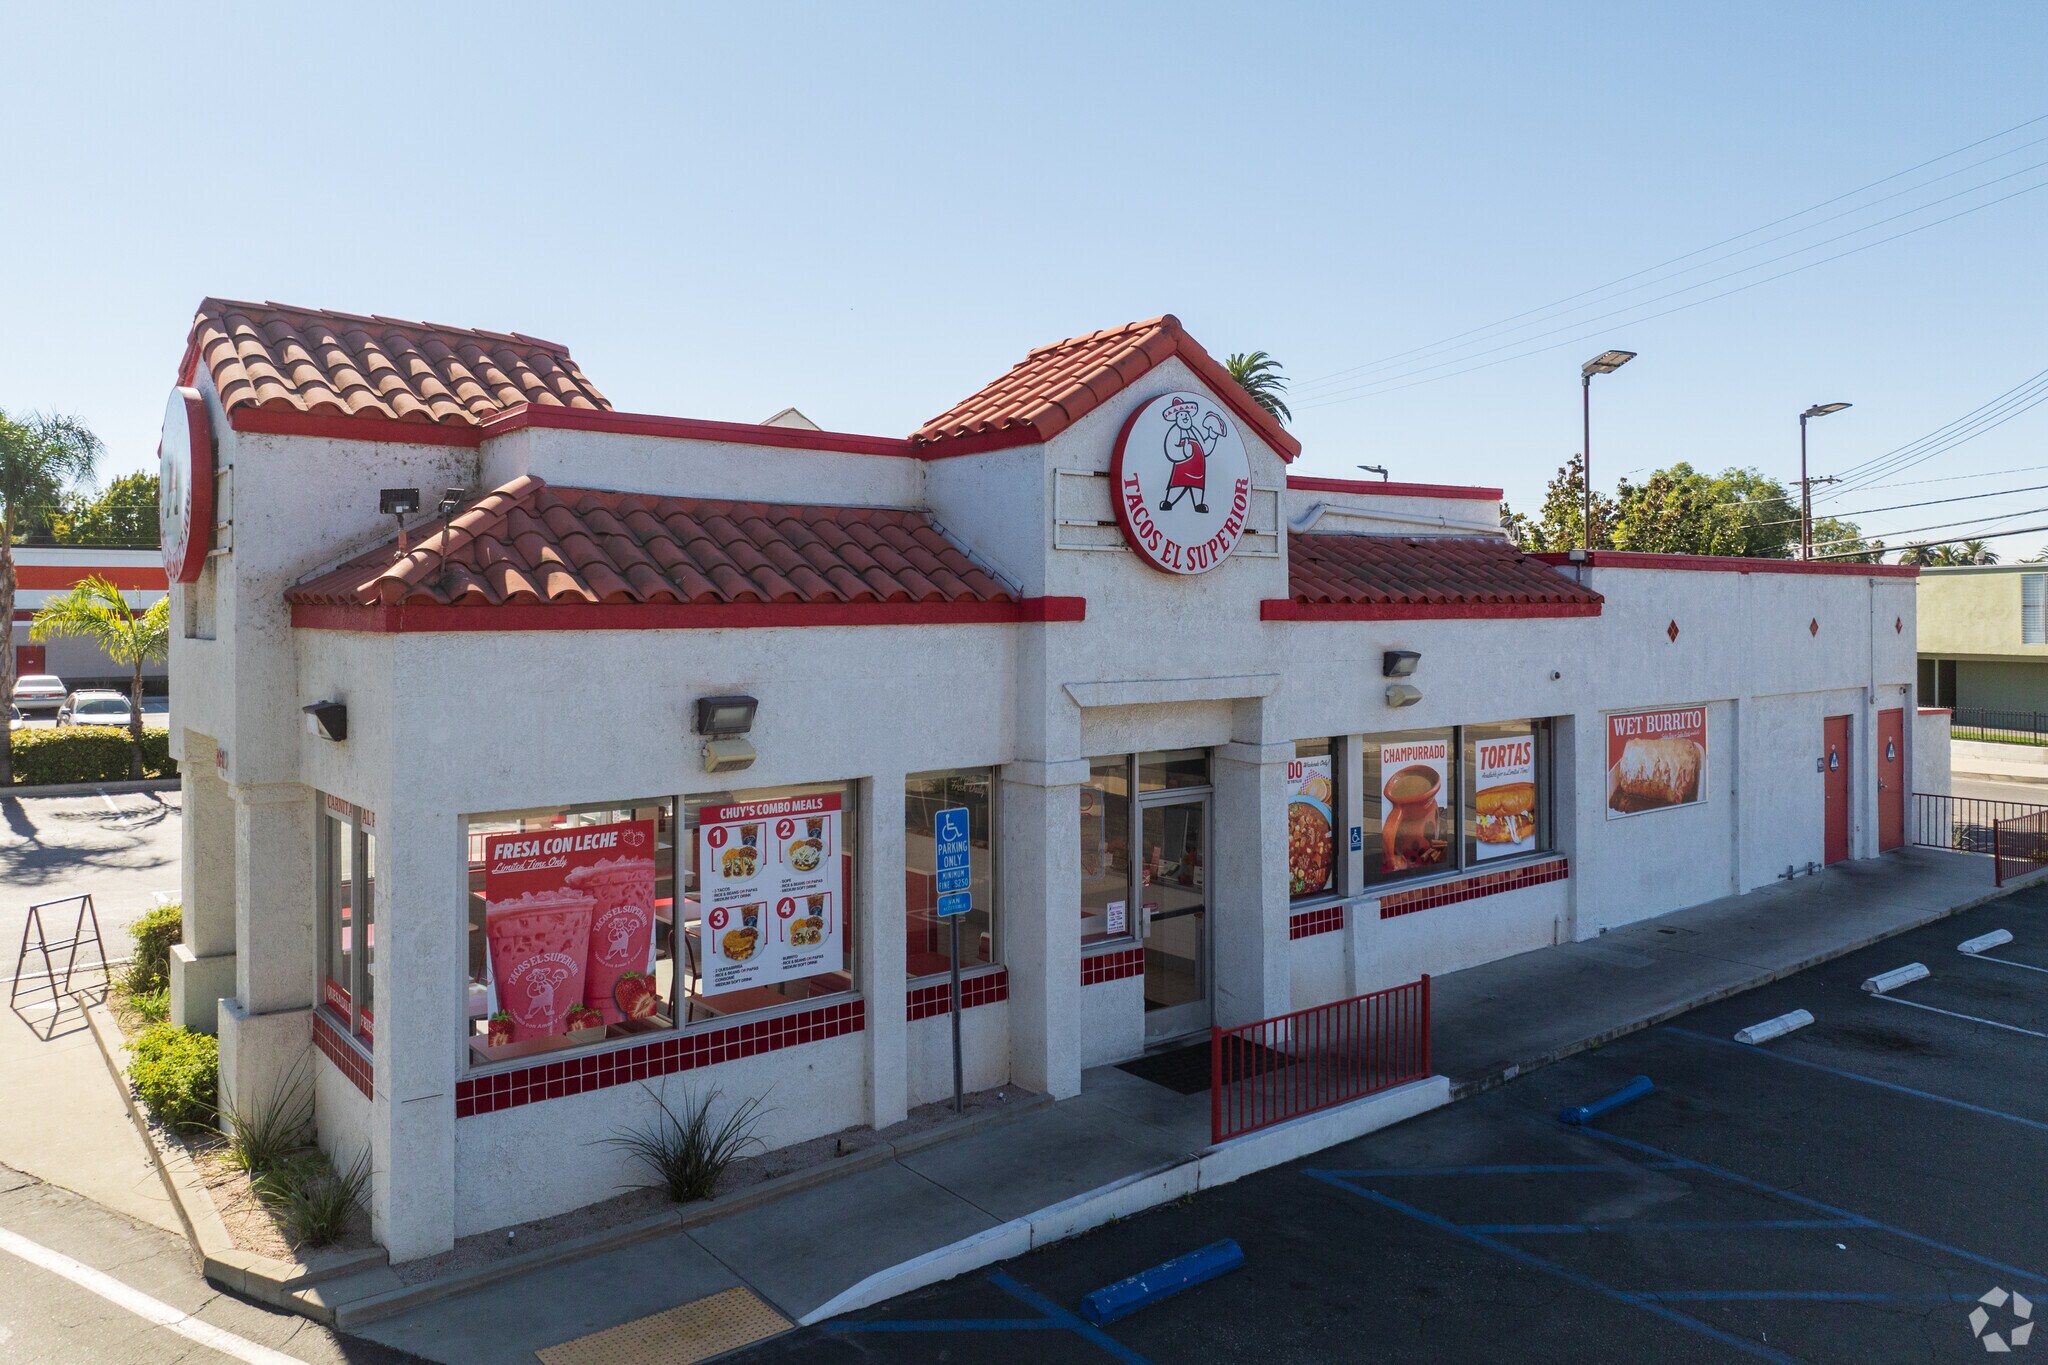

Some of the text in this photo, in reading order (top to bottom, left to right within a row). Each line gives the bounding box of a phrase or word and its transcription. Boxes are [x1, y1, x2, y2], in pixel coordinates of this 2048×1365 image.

[1124, 473, 1248, 571] TACOS EL SUPERIOR
[1614, 717, 1643, 736] WET
[1646, 711, 1701, 733] BURRITO
[1384, 745, 1444, 763] CHAMPURRADO
[1481, 742, 1531, 770] TORTAS
[720, 798, 823, 819] CHUY'S COMBO MEALS
[713, 830, 720, 844] 1
[780, 822, 790, 836] 2
[494, 832, 618, 860] FRESA CON LECHE
[938, 840, 967, 855] PARKING
[494, 856, 568, 873] Limited Time Only
[944, 855, 962, 868] ONLY
[943, 870, 964, 880] MINIMUM
[939, 881, 950, 890] FINE
[612, 907, 622, 915] EL
[782, 900, 791, 915] 4
[714, 910, 724, 926] 3
[508, 960, 530, 986] TACOS
[530, 954, 544, 966] EL
[544, 952, 578, 976] SUPERIOR
